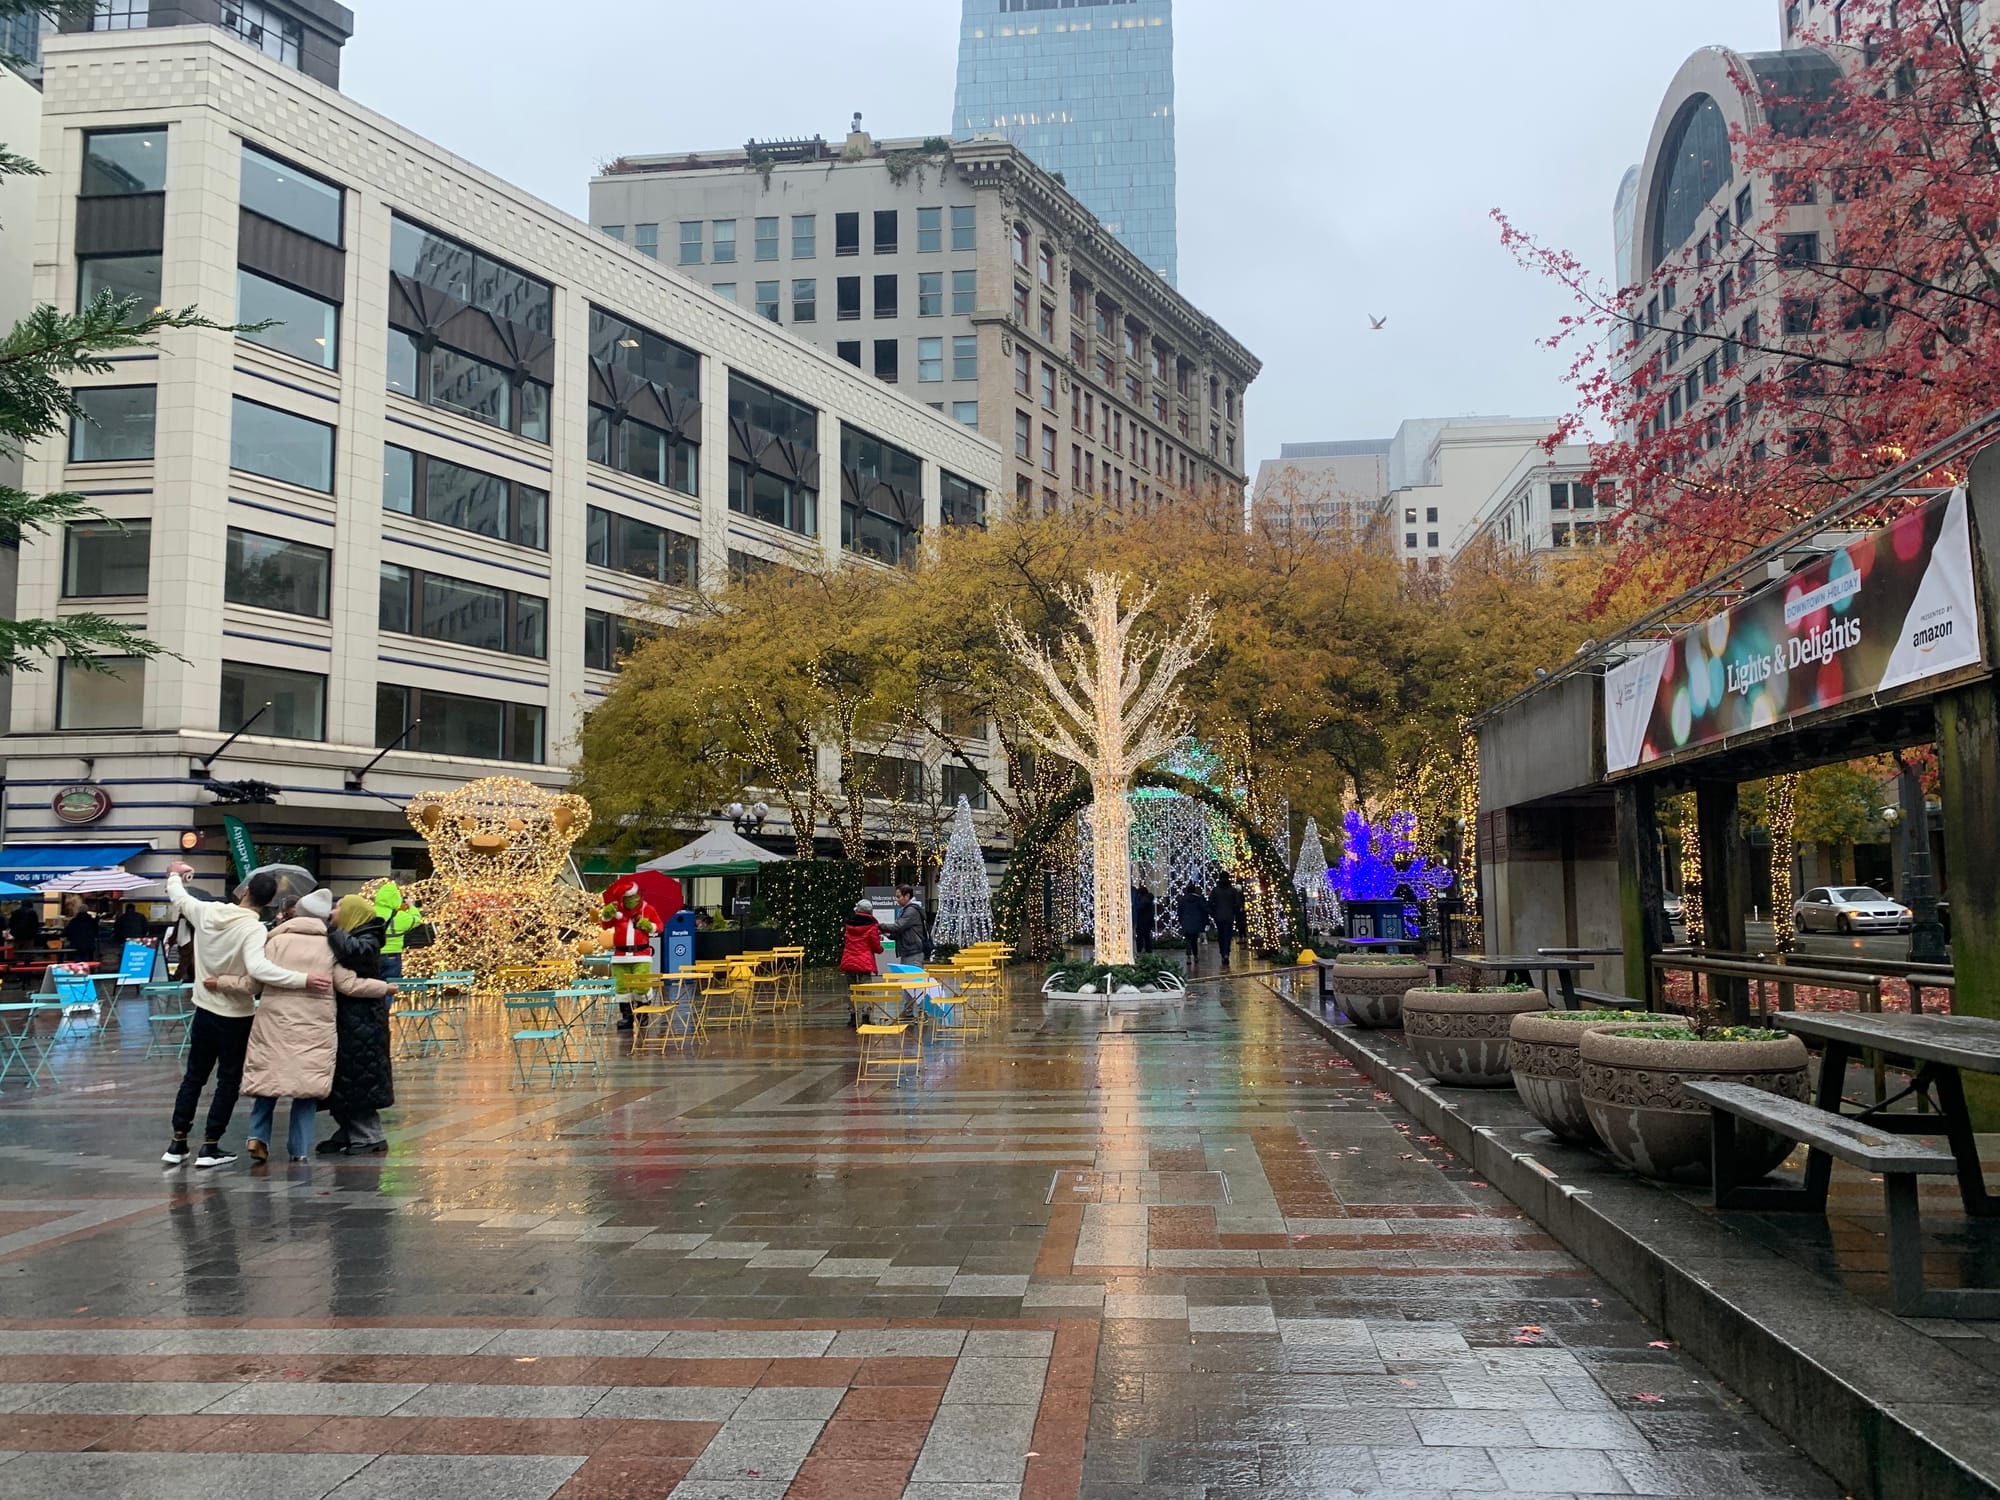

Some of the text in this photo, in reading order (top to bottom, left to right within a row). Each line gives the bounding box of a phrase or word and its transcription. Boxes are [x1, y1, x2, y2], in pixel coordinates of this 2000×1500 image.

[1787, 576, 1858, 618] DOWNTOWN HOLIDAY
[1913, 620, 1953, 648] amazon
[1727, 616, 1861, 695] Lights & Delights
[233, 825, 249, 862] Activity
[14, 873, 31, 881] DOG
[32, 873, 40, 881] IN
